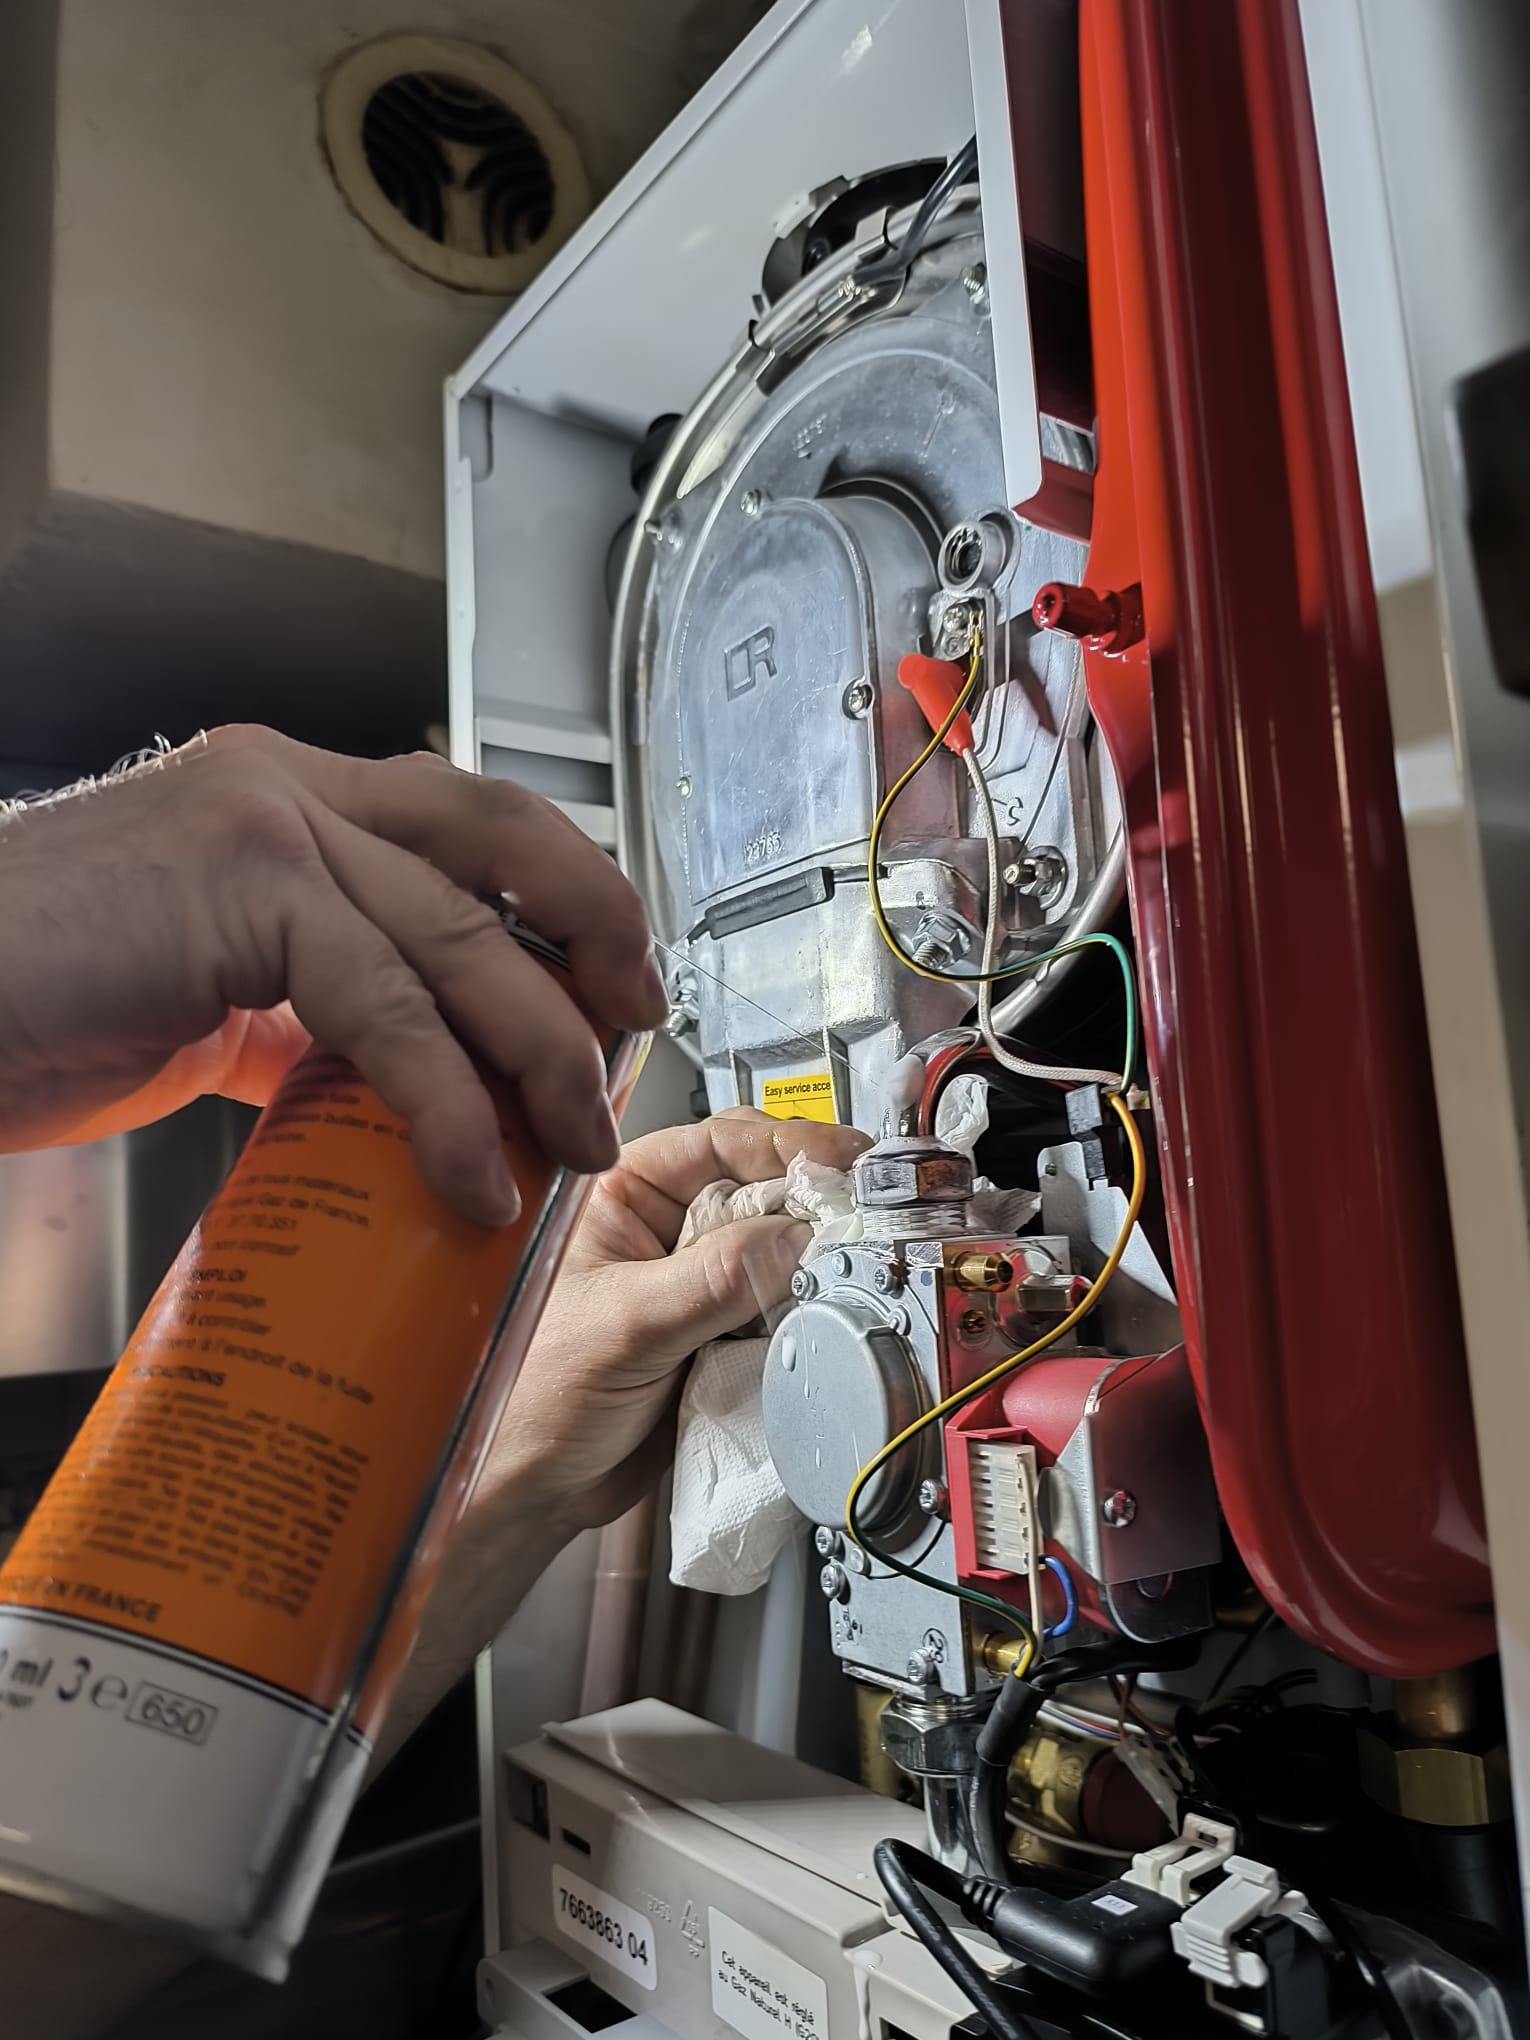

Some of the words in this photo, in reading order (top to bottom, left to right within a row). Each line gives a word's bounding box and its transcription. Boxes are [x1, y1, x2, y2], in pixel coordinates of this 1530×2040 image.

[765, 1086, 782, 1097] Easy
[784, 1082, 810, 1094] service
[73, 1583, 161, 1621] FRANCE
[141, 1693, 207, 1737] 650
[560, 1887, 624, 1949] 7663863
[627, 1931, 649, 1966] 04
